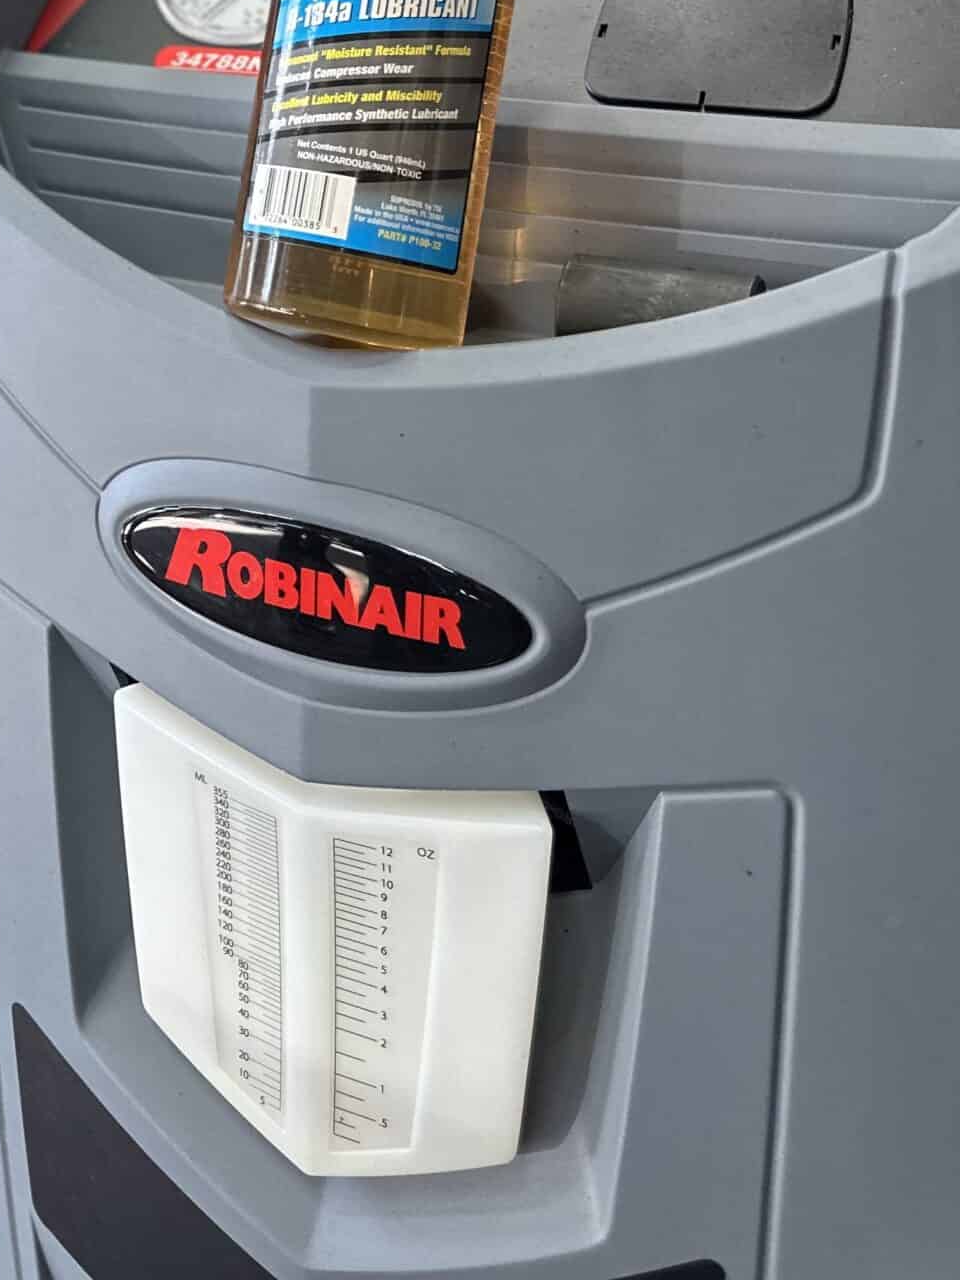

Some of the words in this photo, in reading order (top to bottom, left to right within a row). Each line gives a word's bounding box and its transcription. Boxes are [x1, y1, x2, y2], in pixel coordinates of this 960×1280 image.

[435, 44, 472, 57] Formula
[313, 63, 381, 79] Compressor
[383, 63, 415, 75] Wear
[311, 91, 359, 106] Lubricity
[361, 91, 382, 103] and
[385, 89, 443, 104] Miscibility
[287, 108, 353, 127] Performance
[354, 107, 410, 125] Synthetic
[411, 106, 459, 120] Lubricant
[296, 139, 310, 149] Net
[311, 140, 346, 154] Contents
[348, 146, 353, 155] 1
[355, 147, 369, 157] US
[369, 150, 394, 162] Quart
[164, 527, 466, 651] ROBINAIR
[194, 770, 208, 785] ML
[213, 785, 229, 800] 355
[214, 795, 229, 810] 340
[214, 805, 230, 819] 320
[215, 826, 231, 840] 280
[215, 837, 231, 851] 260
[215, 847, 232, 861] 240
[380, 845, 393, 858] 12
[416, 847, 436, 860] OZ
[216, 858, 232, 871] 220
[381, 862, 393, 874] 11
[216, 868, 232, 882] 200
[217, 880, 233, 895] 180
[380, 878, 394, 890] 10
[217, 893, 233, 907] 160
[380, 893, 388, 902] 9
[217, 905, 233, 920] 140
[380, 910, 388, 920] 8
[218, 918, 233, 932] 120
[380, 925, 388, 935] 7
[218, 933, 234, 948] 100
[222, 946, 234, 958] 90
[380, 946, 388, 956] 6
[238, 959, 249, 971] 80
[380, 965, 388, 975] 5
[238, 969, 249, 981] 70
[238, 979, 249, 992] 60
[380, 985, 388, 994] 4
[238, 991, 250, 1004] 50
[237, 1007, 250, 1019] 40
[380, 1010, 388, 1021] 3
[238, 1025, 250, 1038] 30
[380, 1038, 387, 1049] 2
[238, 1048, 250, 1062] 20
[239, 1067, 249, 1080] 10
[259, 1095, 266, 1105] 5
